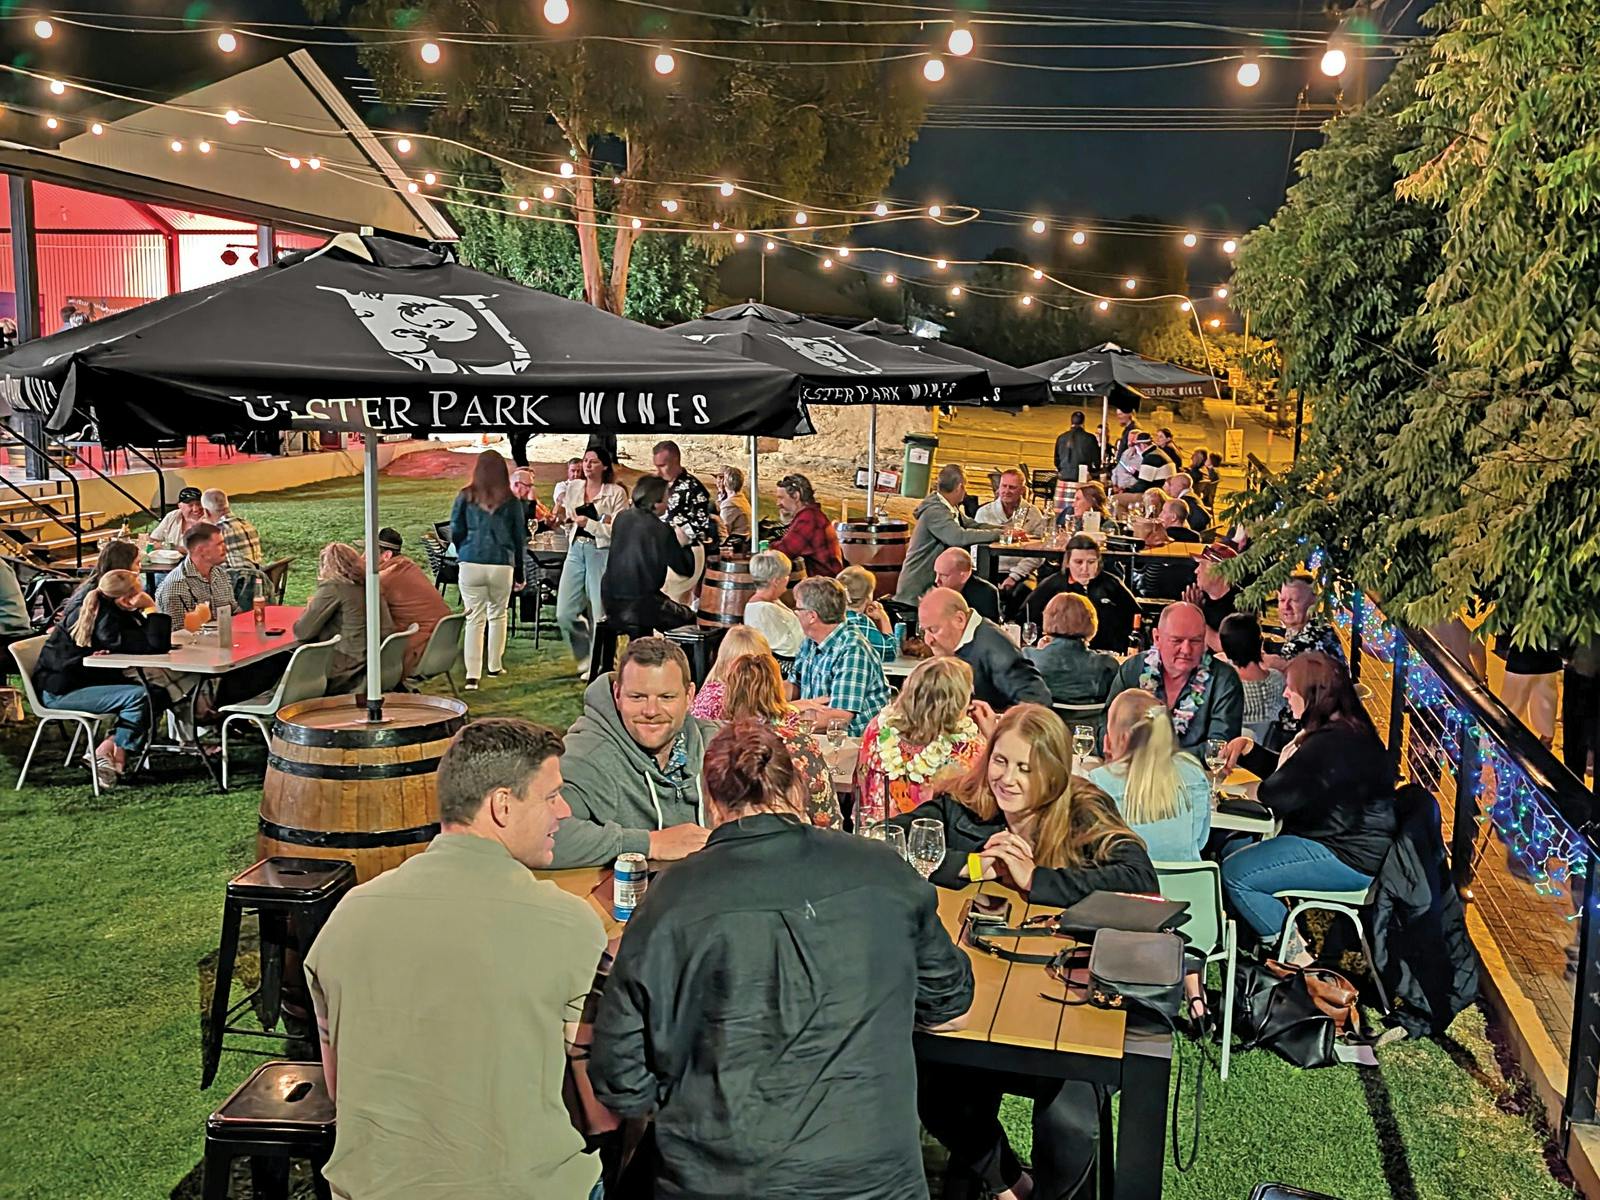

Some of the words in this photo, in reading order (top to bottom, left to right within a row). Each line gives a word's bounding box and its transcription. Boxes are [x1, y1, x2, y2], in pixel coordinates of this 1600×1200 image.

[856, 385, 900, 402] PARK
[428, 390, 550, 427] PARK
[579, 391, 711, 427] WINES
